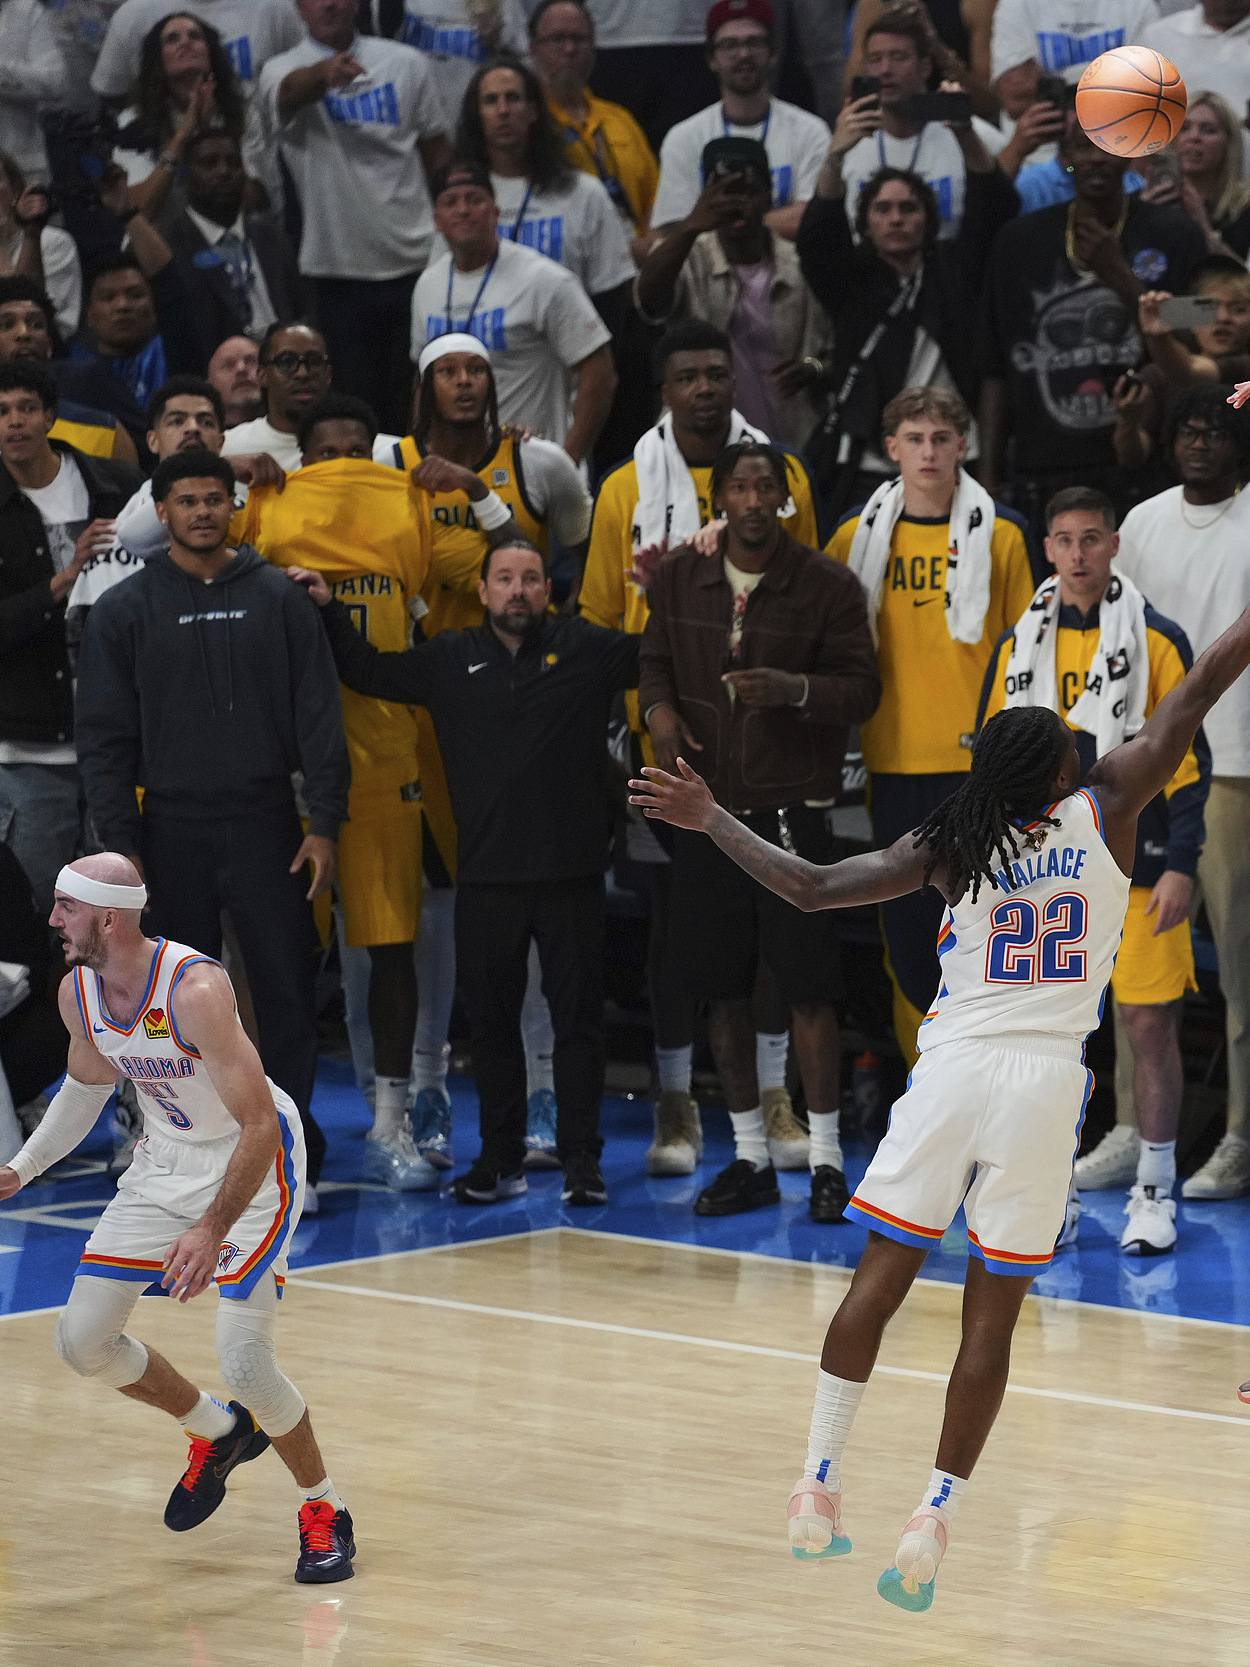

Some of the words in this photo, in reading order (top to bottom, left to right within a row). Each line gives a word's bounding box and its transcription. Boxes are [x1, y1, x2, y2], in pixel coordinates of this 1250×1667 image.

[993, 847, 1087, 895] WALLACE
[984, 891, 1089, 985] 22
[152, 1096, 194, 1131] 9
